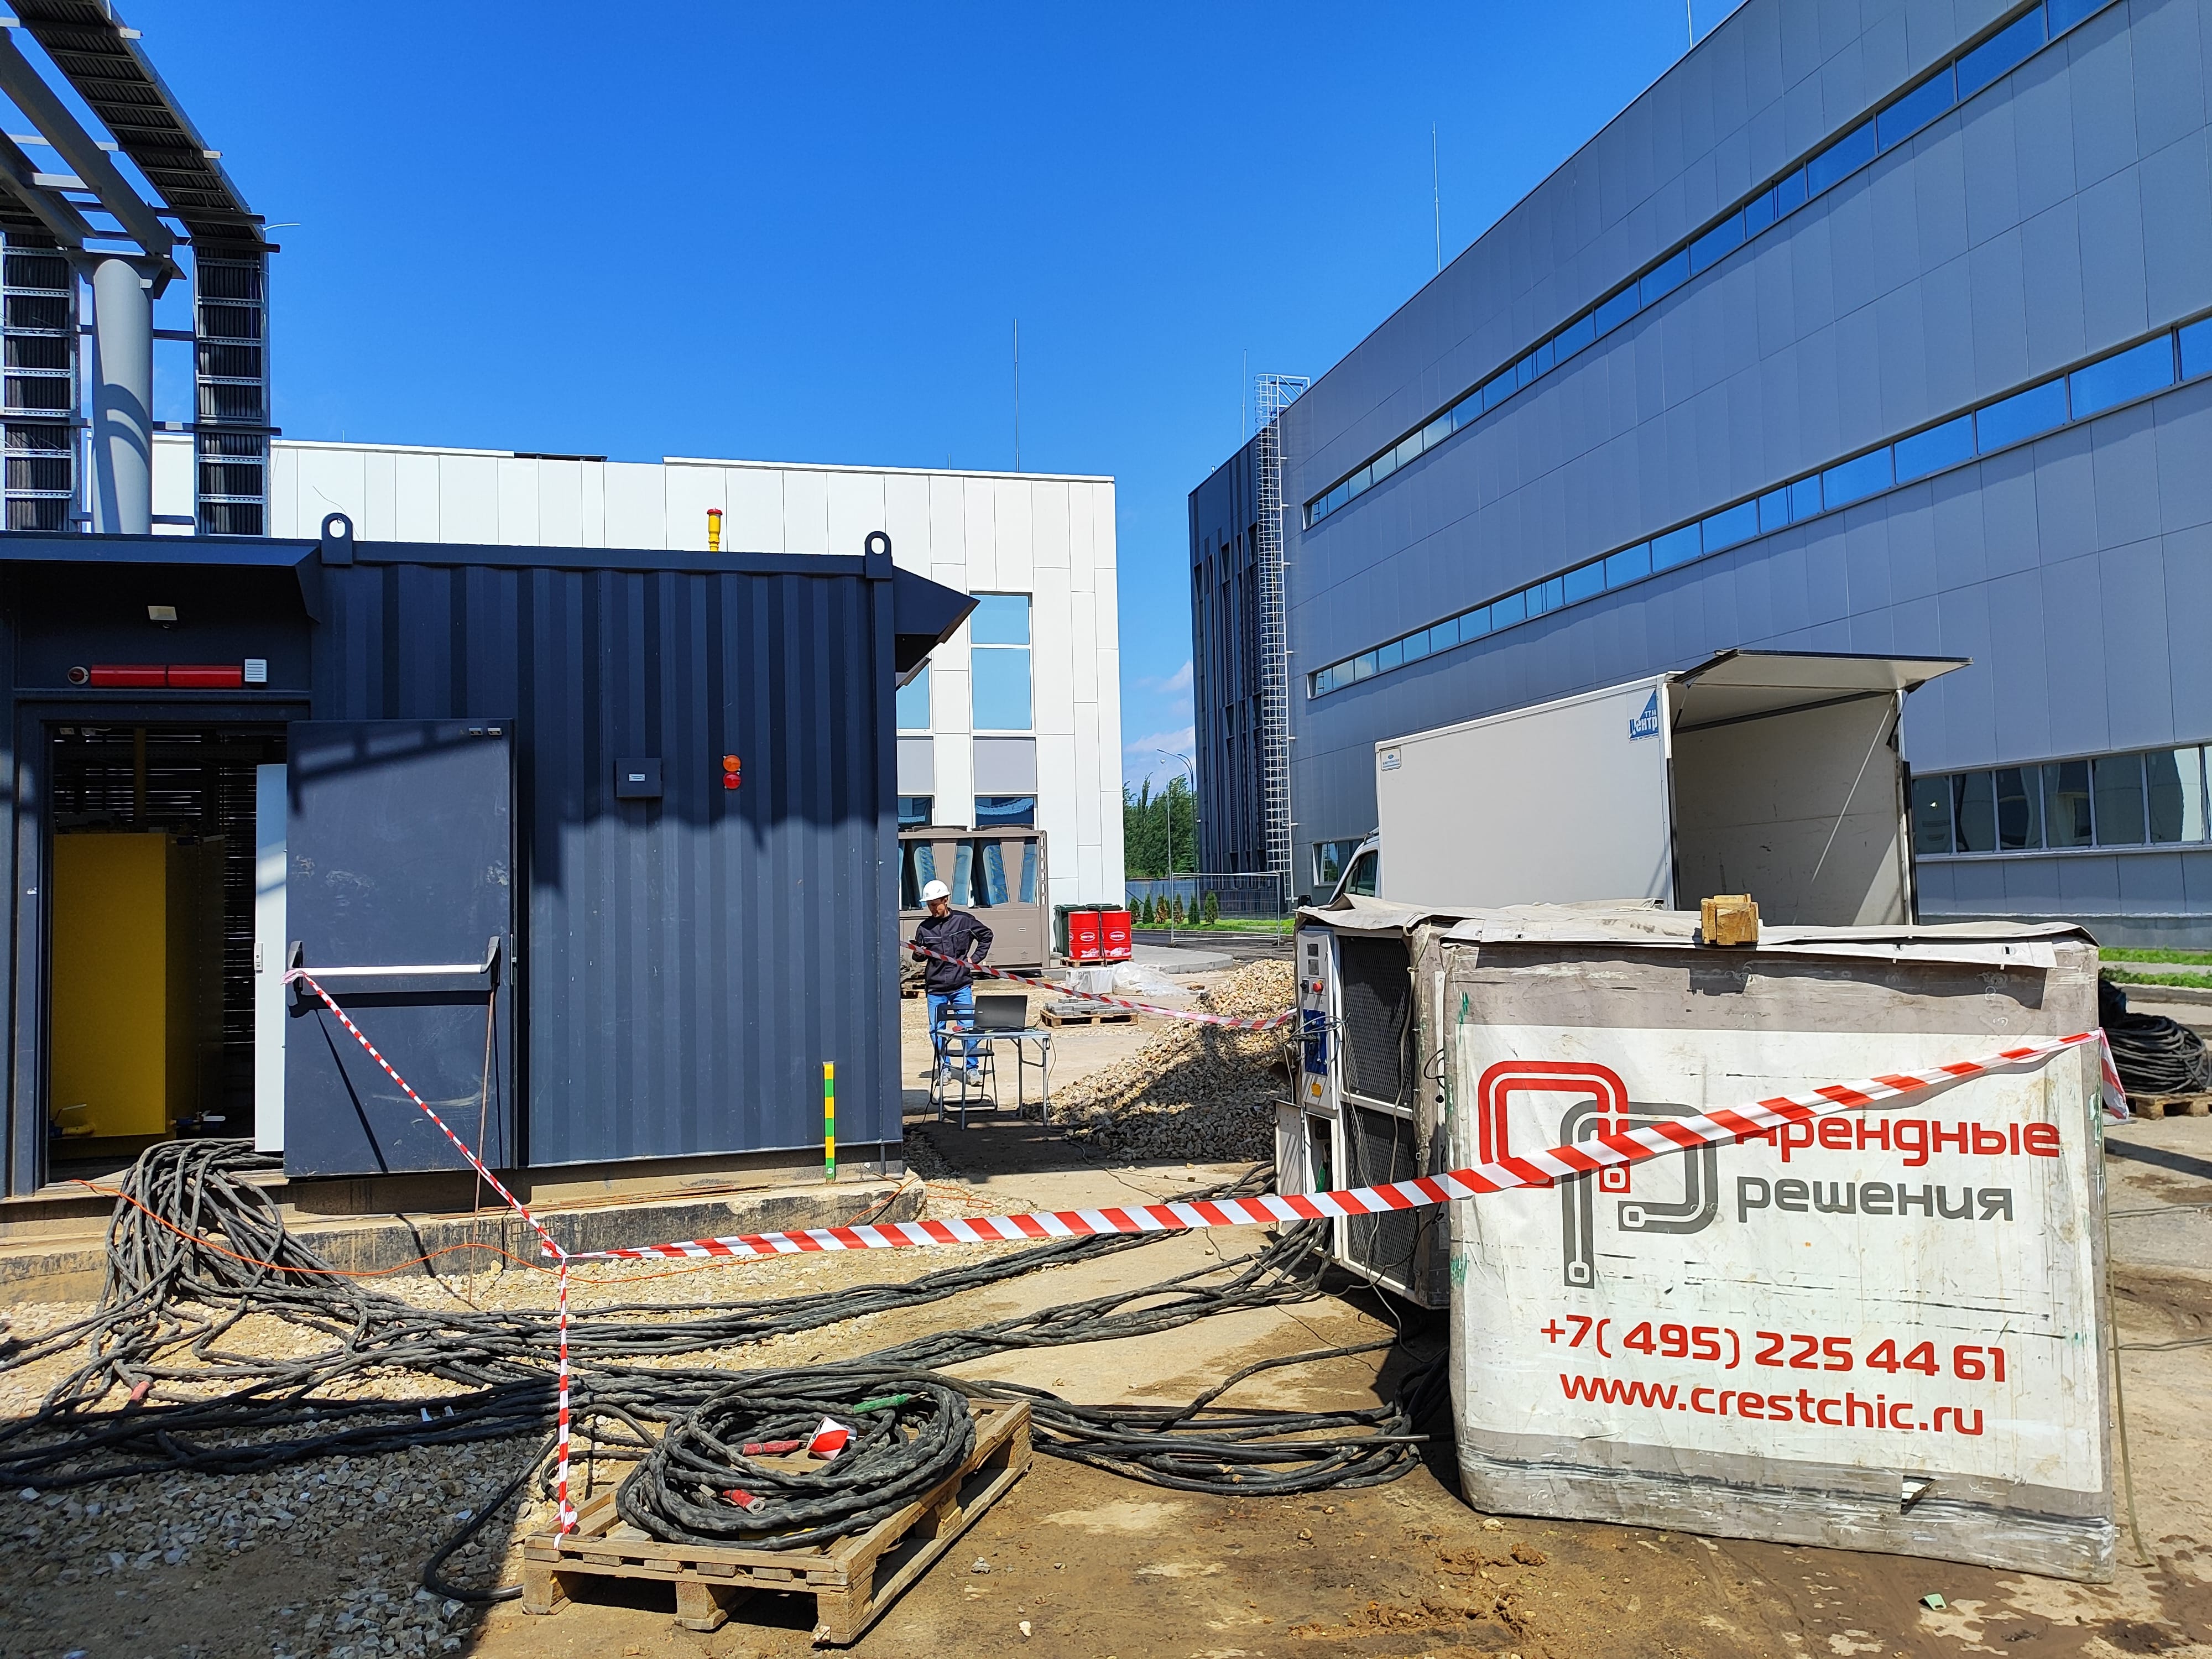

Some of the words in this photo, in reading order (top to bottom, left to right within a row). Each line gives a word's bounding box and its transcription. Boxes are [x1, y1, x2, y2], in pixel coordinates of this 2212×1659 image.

[1629, 716, 1657, 735] Центр
[1645, 709, 1657, 717] ТТМ
[1737, 1176, 2013, 1223] решения
[1755, 1331, 1853, 1371] 225
[1866, 1339, 1940, 1376] 44
[1953, 1345, 2005, 1382] 61
[1560, 1374, 1983, 1436] www.crestchic.ru
